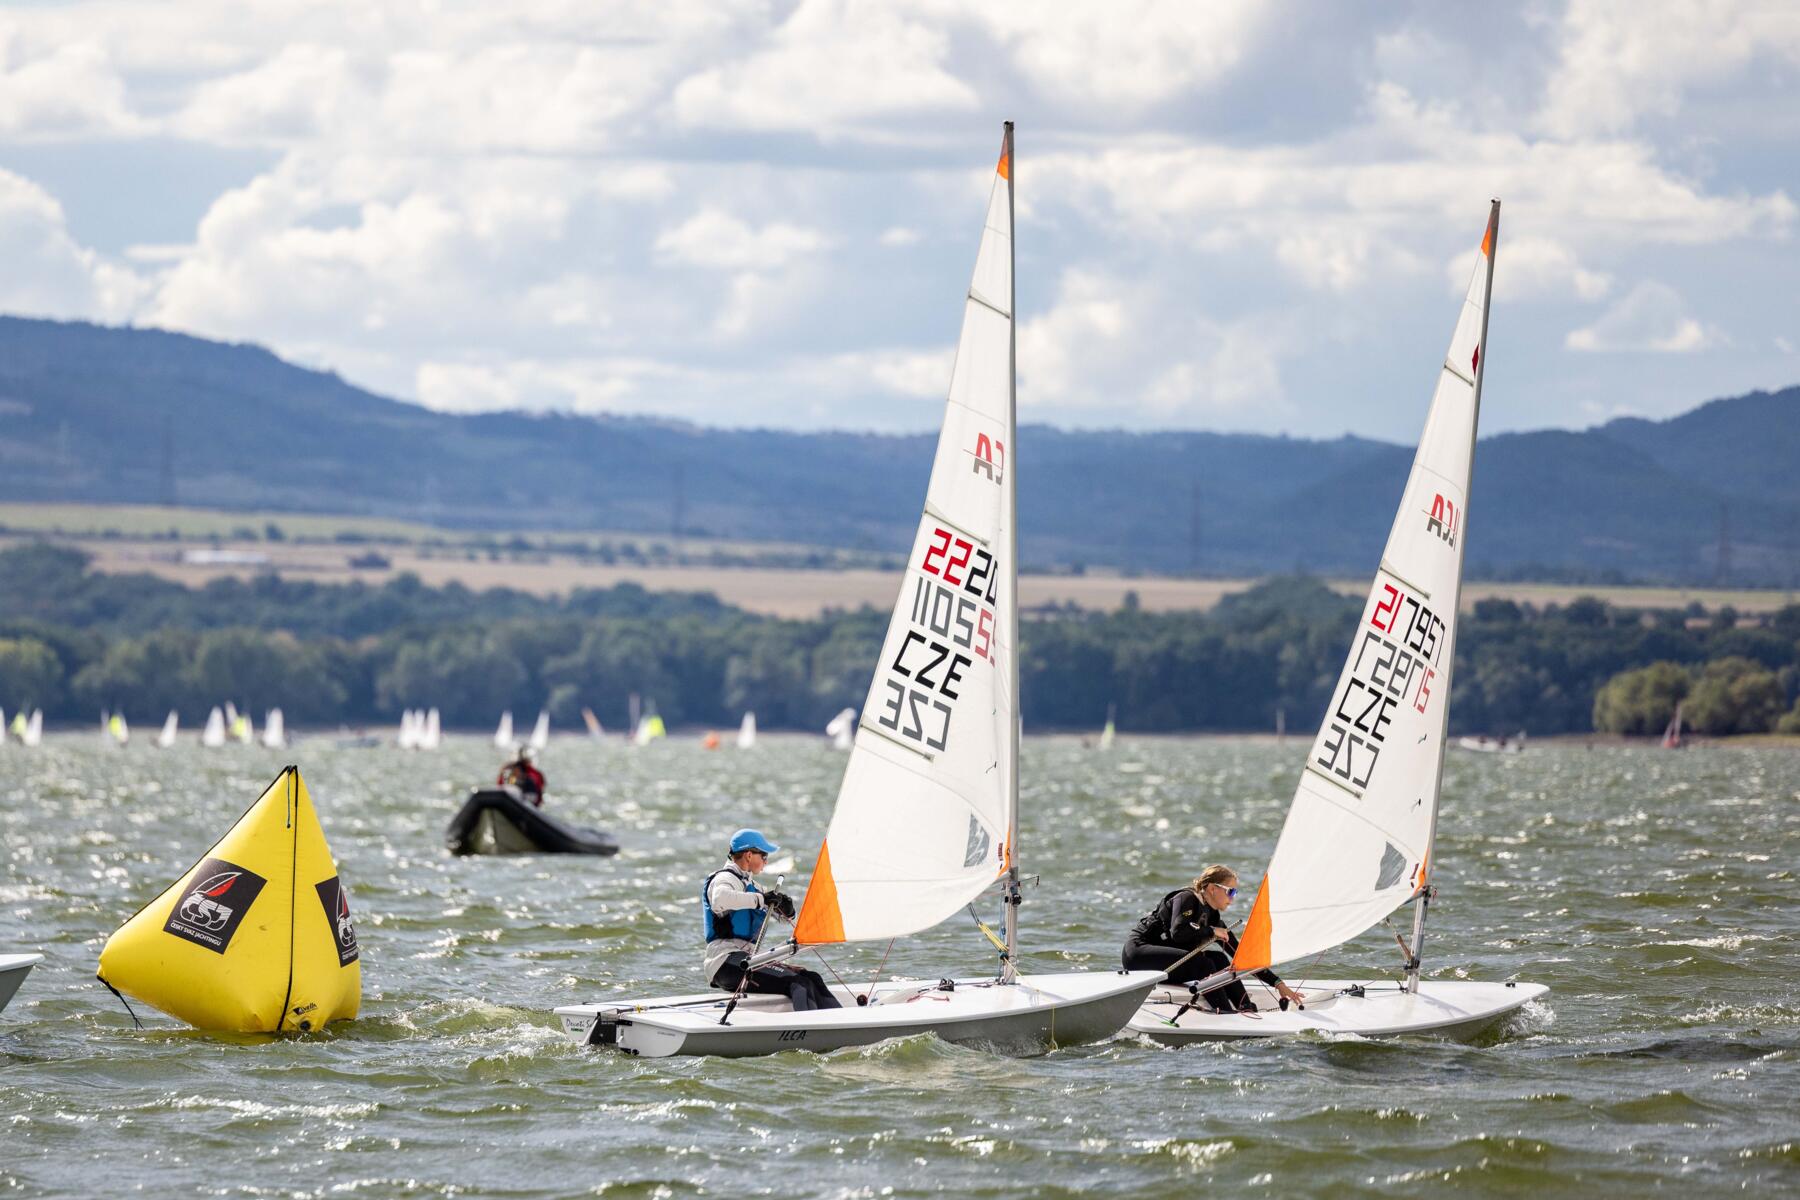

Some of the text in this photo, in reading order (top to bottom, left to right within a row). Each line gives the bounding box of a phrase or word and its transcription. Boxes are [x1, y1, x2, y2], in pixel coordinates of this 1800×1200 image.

[892, 630, 972, 700] CZE
[1336, 676, 1398, 742] CZE
[777, 1030, 807, 1041] ILCA
